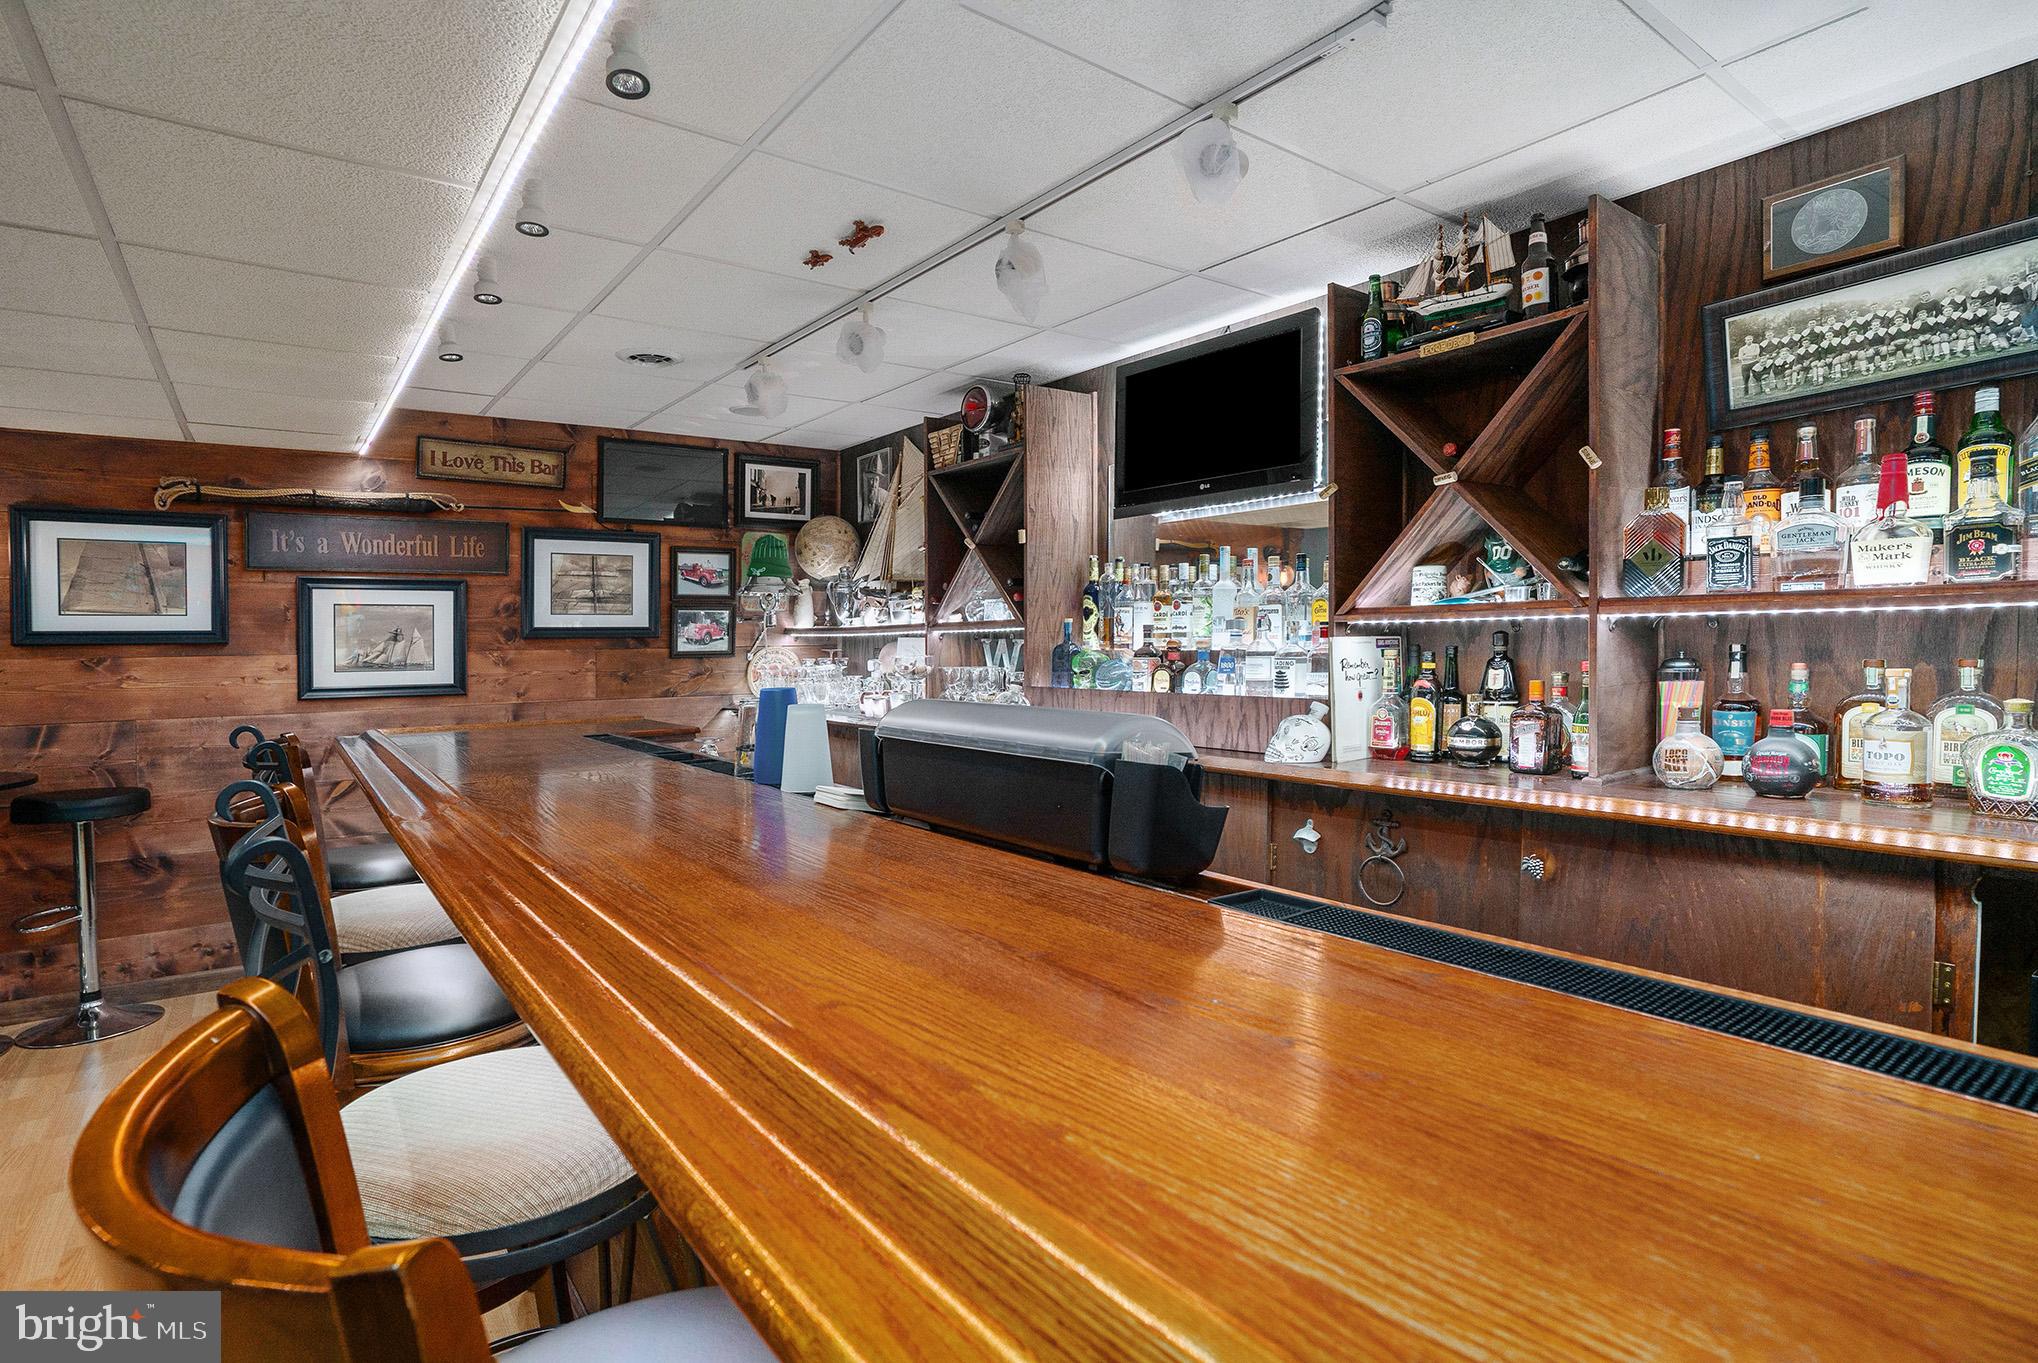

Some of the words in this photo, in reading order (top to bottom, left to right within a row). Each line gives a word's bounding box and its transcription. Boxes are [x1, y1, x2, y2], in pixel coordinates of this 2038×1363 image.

[430, 450, 436, 466] I
[441, 451, 488, 474] Love
[488, 452, 526, 474] This
[530, 459, 559, 475] Bar
[1907, 466, 1946, 477] MESON
[2020, 466, 2038, 476] BLAC
[1746, 498, 1782, 511] AND-DAD
[1840, 507, 1860, 518] 101
[1694, 514, 1722, 524] INDS
[1781, 530, 1831, 539] GENTLEMAN
[1956, 533, 1973, 544] JIM
[1973, 529, 1998, 542] BEAM
[270, 529, 305, 553] It's
[317, 537, 330, 555] a
[340, 532, 440, 557] Wonderful
[449, 535, 486, 558] Life
[1708, 543, 1723, 555] JACK
[1857, 542, 1913, 553] Maker's
[1872, 551, 1912, 561] Mark
[1943, 742, 1959, 752] BIR
[1865, 751, 1905, 761] TOPO
